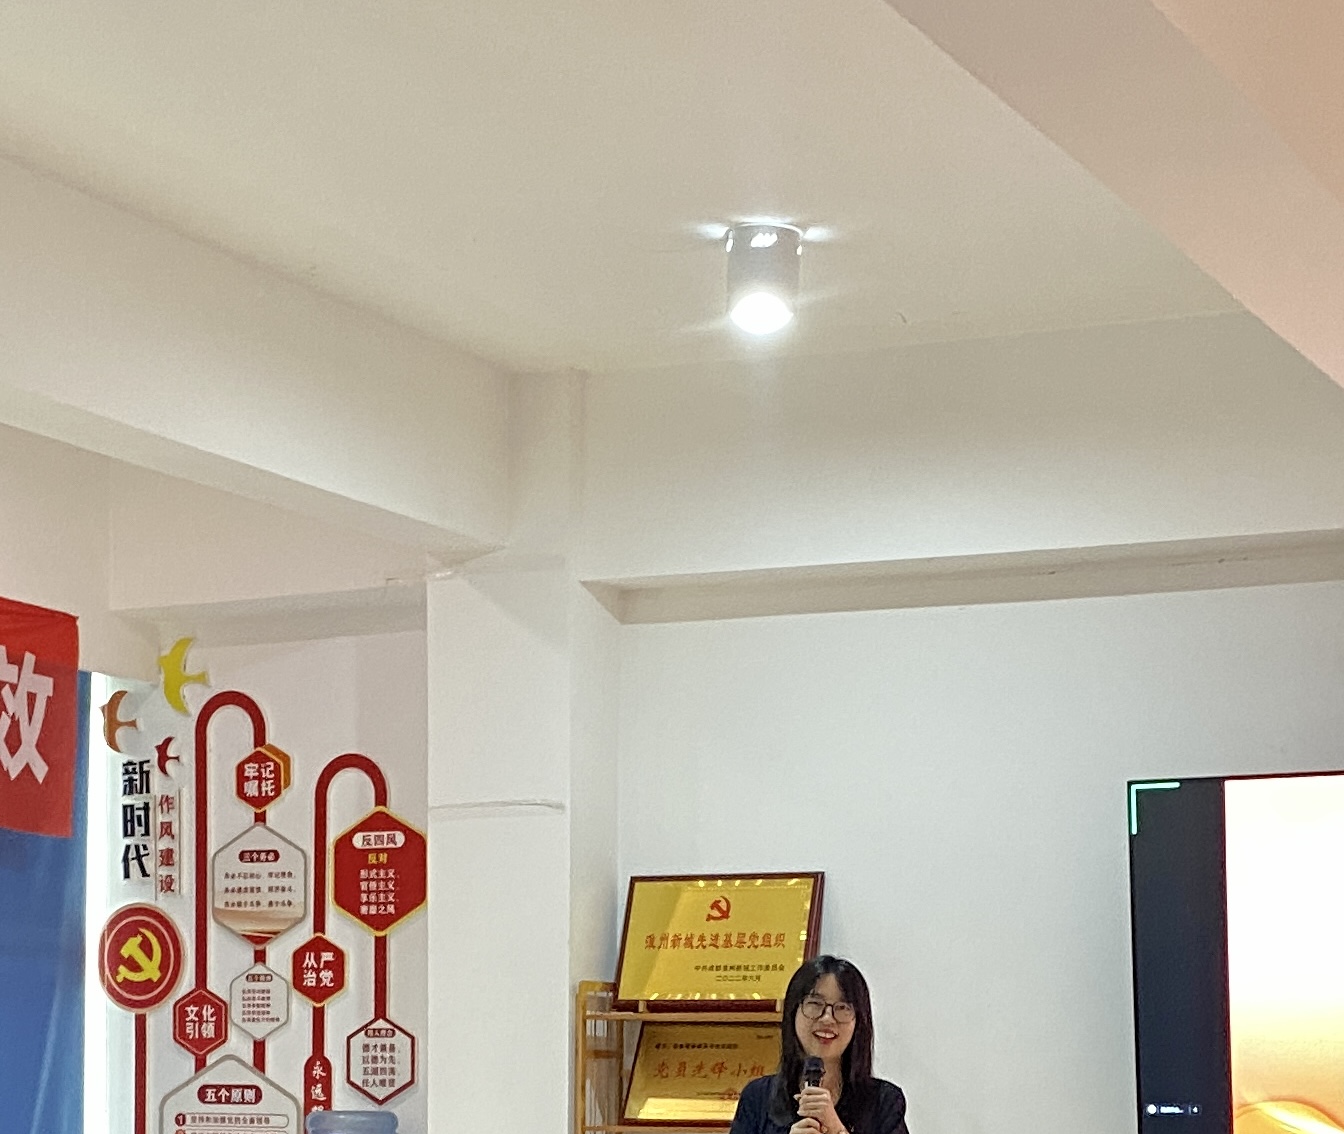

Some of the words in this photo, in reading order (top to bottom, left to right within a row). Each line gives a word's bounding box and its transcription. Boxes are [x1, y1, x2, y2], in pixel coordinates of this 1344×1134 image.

[243, 762, 275, 779] 牢记
[243, 780, 276, 797] 嘱托
[122, 759, 150, 880] 新时代
[158, 794, 175, 893] 作风建设
[362, 833, 397, 847] 反四风
[302, 952, 335, 969] 从严
[302, 970, 335, 987] 治党
[184, 1005, 216, 1022] 文化
[185, 1022, 216, 1039] 引领
[204, 1088, 256, 1103] 五个原则
